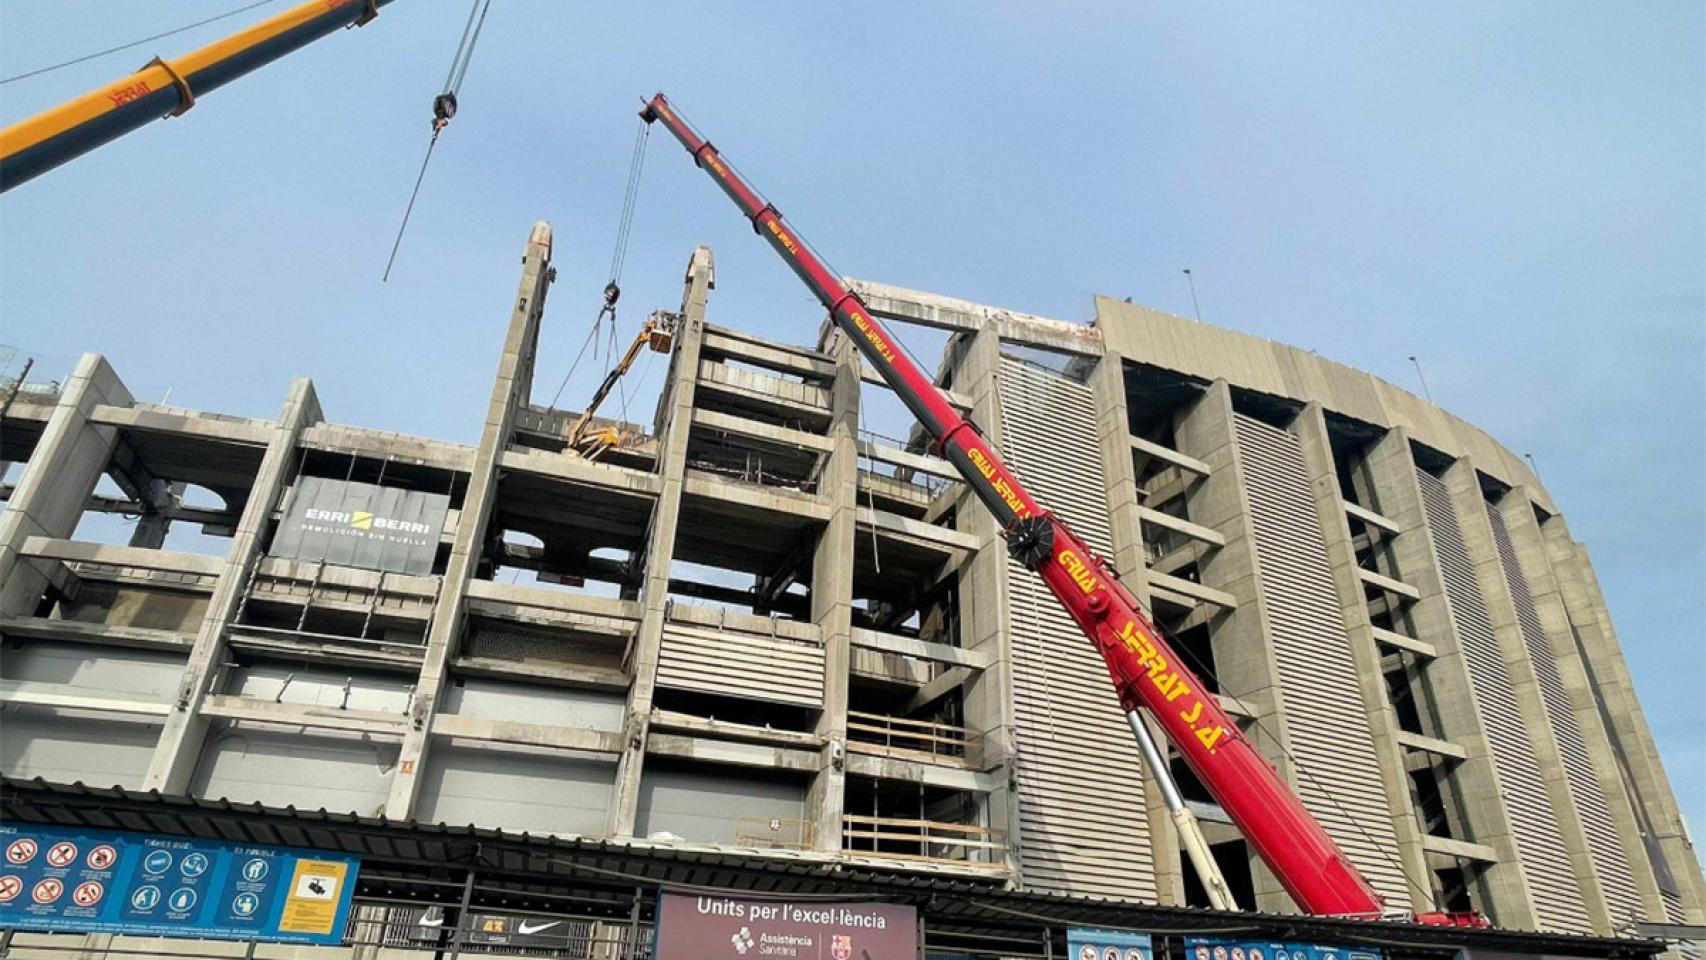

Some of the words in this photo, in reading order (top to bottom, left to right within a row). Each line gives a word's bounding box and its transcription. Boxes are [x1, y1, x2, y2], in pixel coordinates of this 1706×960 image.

[991, 477, 1026, 513] SERRAT
[305, 508, 351, 523] ERRI
[373, 518, 430, 534] BERRI
[1112, 620, 1191, 702] SERRAT
[1180, 701, 1224, 755] S.A.
[697, 897, 745, 916] Units
[750, 904, 778, 922] per
